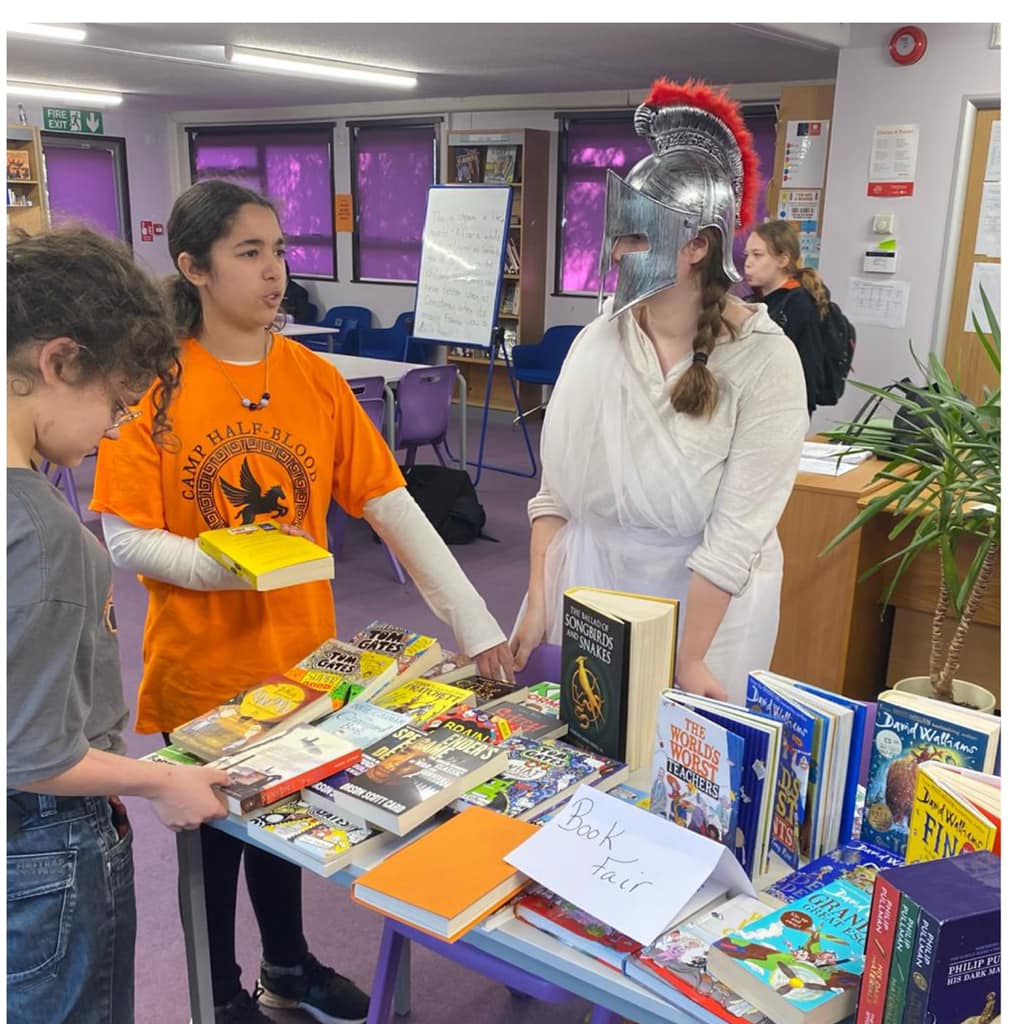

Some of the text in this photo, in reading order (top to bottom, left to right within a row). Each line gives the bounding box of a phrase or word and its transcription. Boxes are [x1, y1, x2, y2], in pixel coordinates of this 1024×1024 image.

[48, 109, 67, 119] FIRE
[48, 120, 67, 129] EXIT
[181, 421, 318, 501] CAMP HALF-BLOOD
[564, 613, 613, 651] SONGBIRDS
[570, 606, 580, 617] THE
[581, 611, 601, 628] BALLAD
[358, 640, 404, 653] GATES
[369, 630, 404, 645] TOM
[566, 629, 611, 665] AND SNAKES
[317, 659, 356, 674] GATES
[329, 651, 357, 664] TOM
[748, 685, 808, 737] David Walliams
[684, 717, 706, 740] THE
[876, 711, 917, 739] David
[919, 725, 978, 754] Walliams
[447, 732, 500, 760] ENDER'S
[670, 724, 721, 766] WORLD'S
[670, 740, 719, 784] WORST
[667, 758, 719, 800] TEACHERS
[363, 790, 390, 807] SCOTT
[918, 786, 944, 816] David
[591, 856, 654, 893] Fair
[802, 904, 844, 927] GREAT
[876, 887, 888, 934] PULLMAN
[884, 900, 893, 931] PHILIP
[896, 904, 909, 952] PULLMAN
[904, 917, 914, 950] PHILIP
[916, 919, 930, 968] PULLMAN
[925, 932, 934, 966] PHILIP
[946, 976, 962, 986] HIS
[964, 969, 987, 981] DARK
[948, 959, 985, 975] PHILIP
